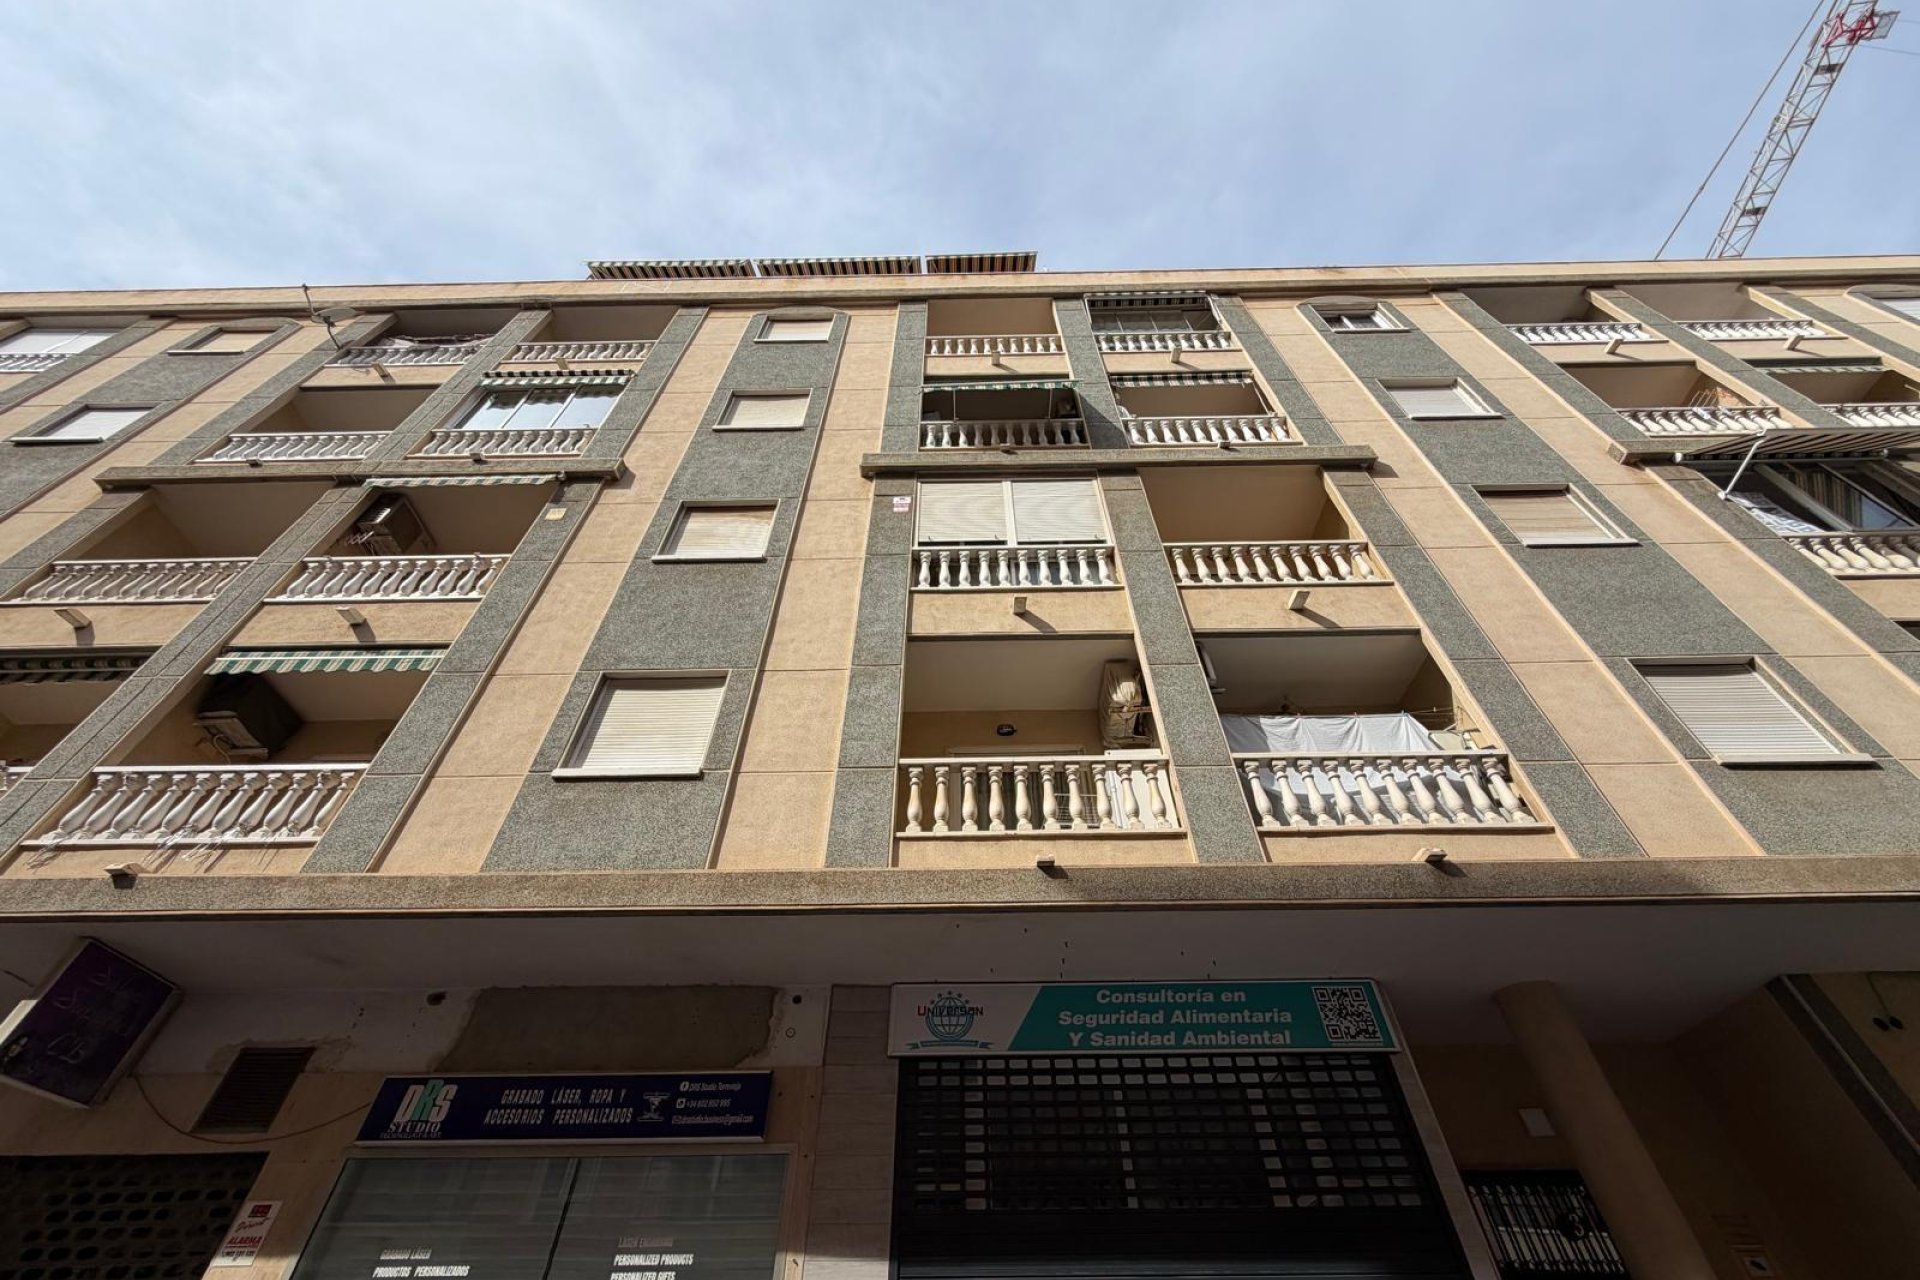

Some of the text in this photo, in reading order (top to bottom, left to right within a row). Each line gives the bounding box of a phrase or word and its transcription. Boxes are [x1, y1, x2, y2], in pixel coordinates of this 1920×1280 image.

[1096, 988, 1246, 1005] Consultoría en
[1058, 1008, 1293, 1027] Seguridad Alimentaria
[1069, 1029, 1292, 1046] Y Sanidad Ambiental
[394, 1079, 458, 1122] DRS
[500, 1087, 627, 1105] GRABADO LÁSER, ROPA Y
[483, 1107, 634, 1125] ACCESORIOS PERSONALIZADOS
[387, 1121, 441, 1133] STUDIO
[227, 1236, 263, 1245] ALARMA
[380, 1248, 411, 1260] GRABADO
[613, 1254, 695, 1266] PERSONALIZED PRODUCTS
[372, 1265, 470, 1278] PRODUCTOS PERSONALIZADOS
[657, 1271, 677, 1280] GIFTS
